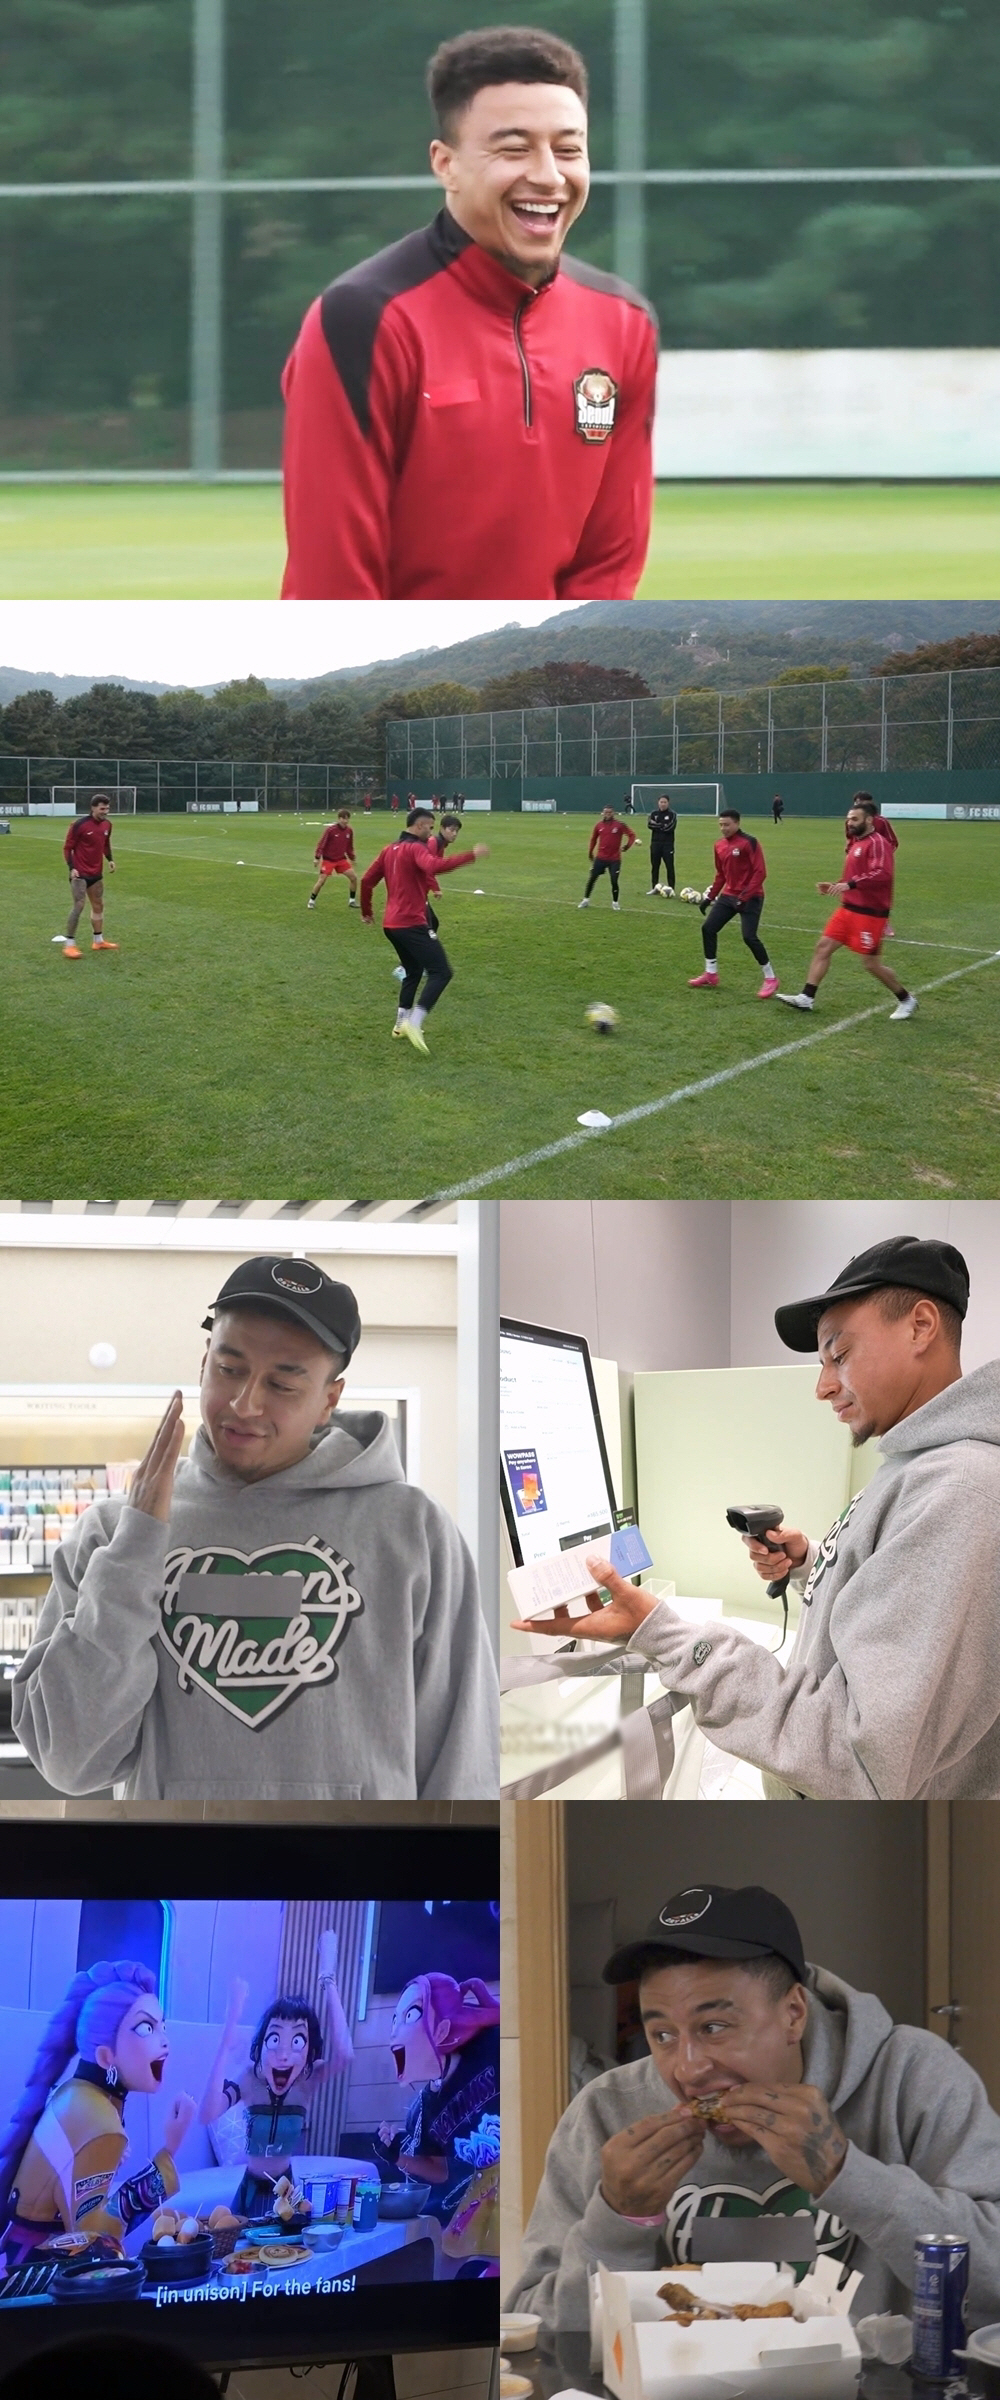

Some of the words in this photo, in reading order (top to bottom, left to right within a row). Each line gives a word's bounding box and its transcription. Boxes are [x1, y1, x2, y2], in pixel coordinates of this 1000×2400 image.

[969, 807, 981, 817] FC
[507, 1451, 535, 1460] WOWPASS
[533, 1551, 546, 1559] Prev
[172, 1613, 335, 1691] Made
[156, 2286, 178, 2308] [in
[183, 2281, 247, 2302] unison]
[251, 2281, 281, 2298] For
[284, 2278, 311, 2296] the
[315, 2275, 356, 2294] fans!
